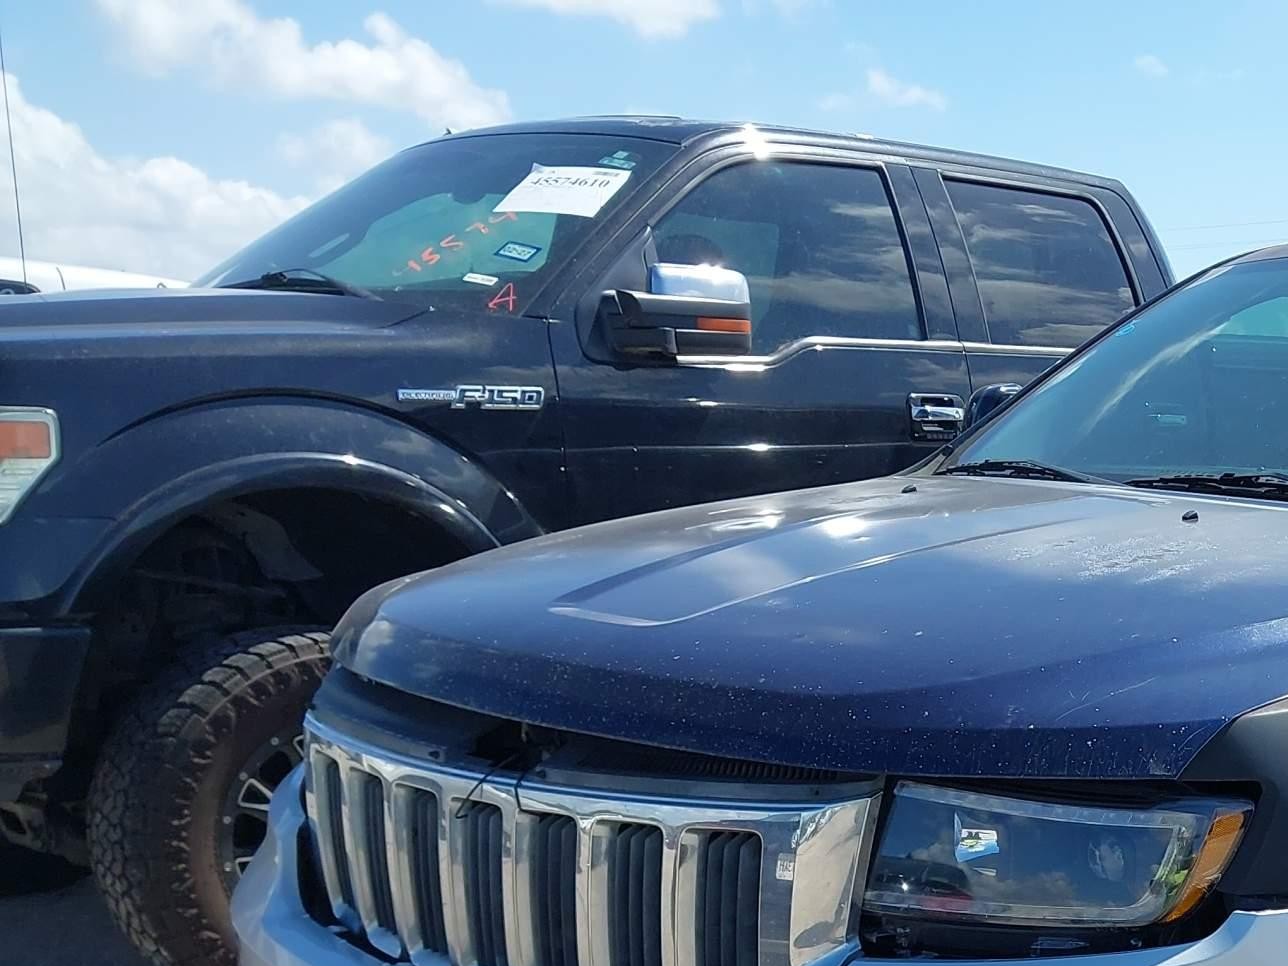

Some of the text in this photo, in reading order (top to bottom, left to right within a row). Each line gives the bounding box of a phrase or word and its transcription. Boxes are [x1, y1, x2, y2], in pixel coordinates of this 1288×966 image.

[530, 176, 611, 188] 45574610
[488, 282, 517, 312] A
[451, 385, 545, 409] F-150
